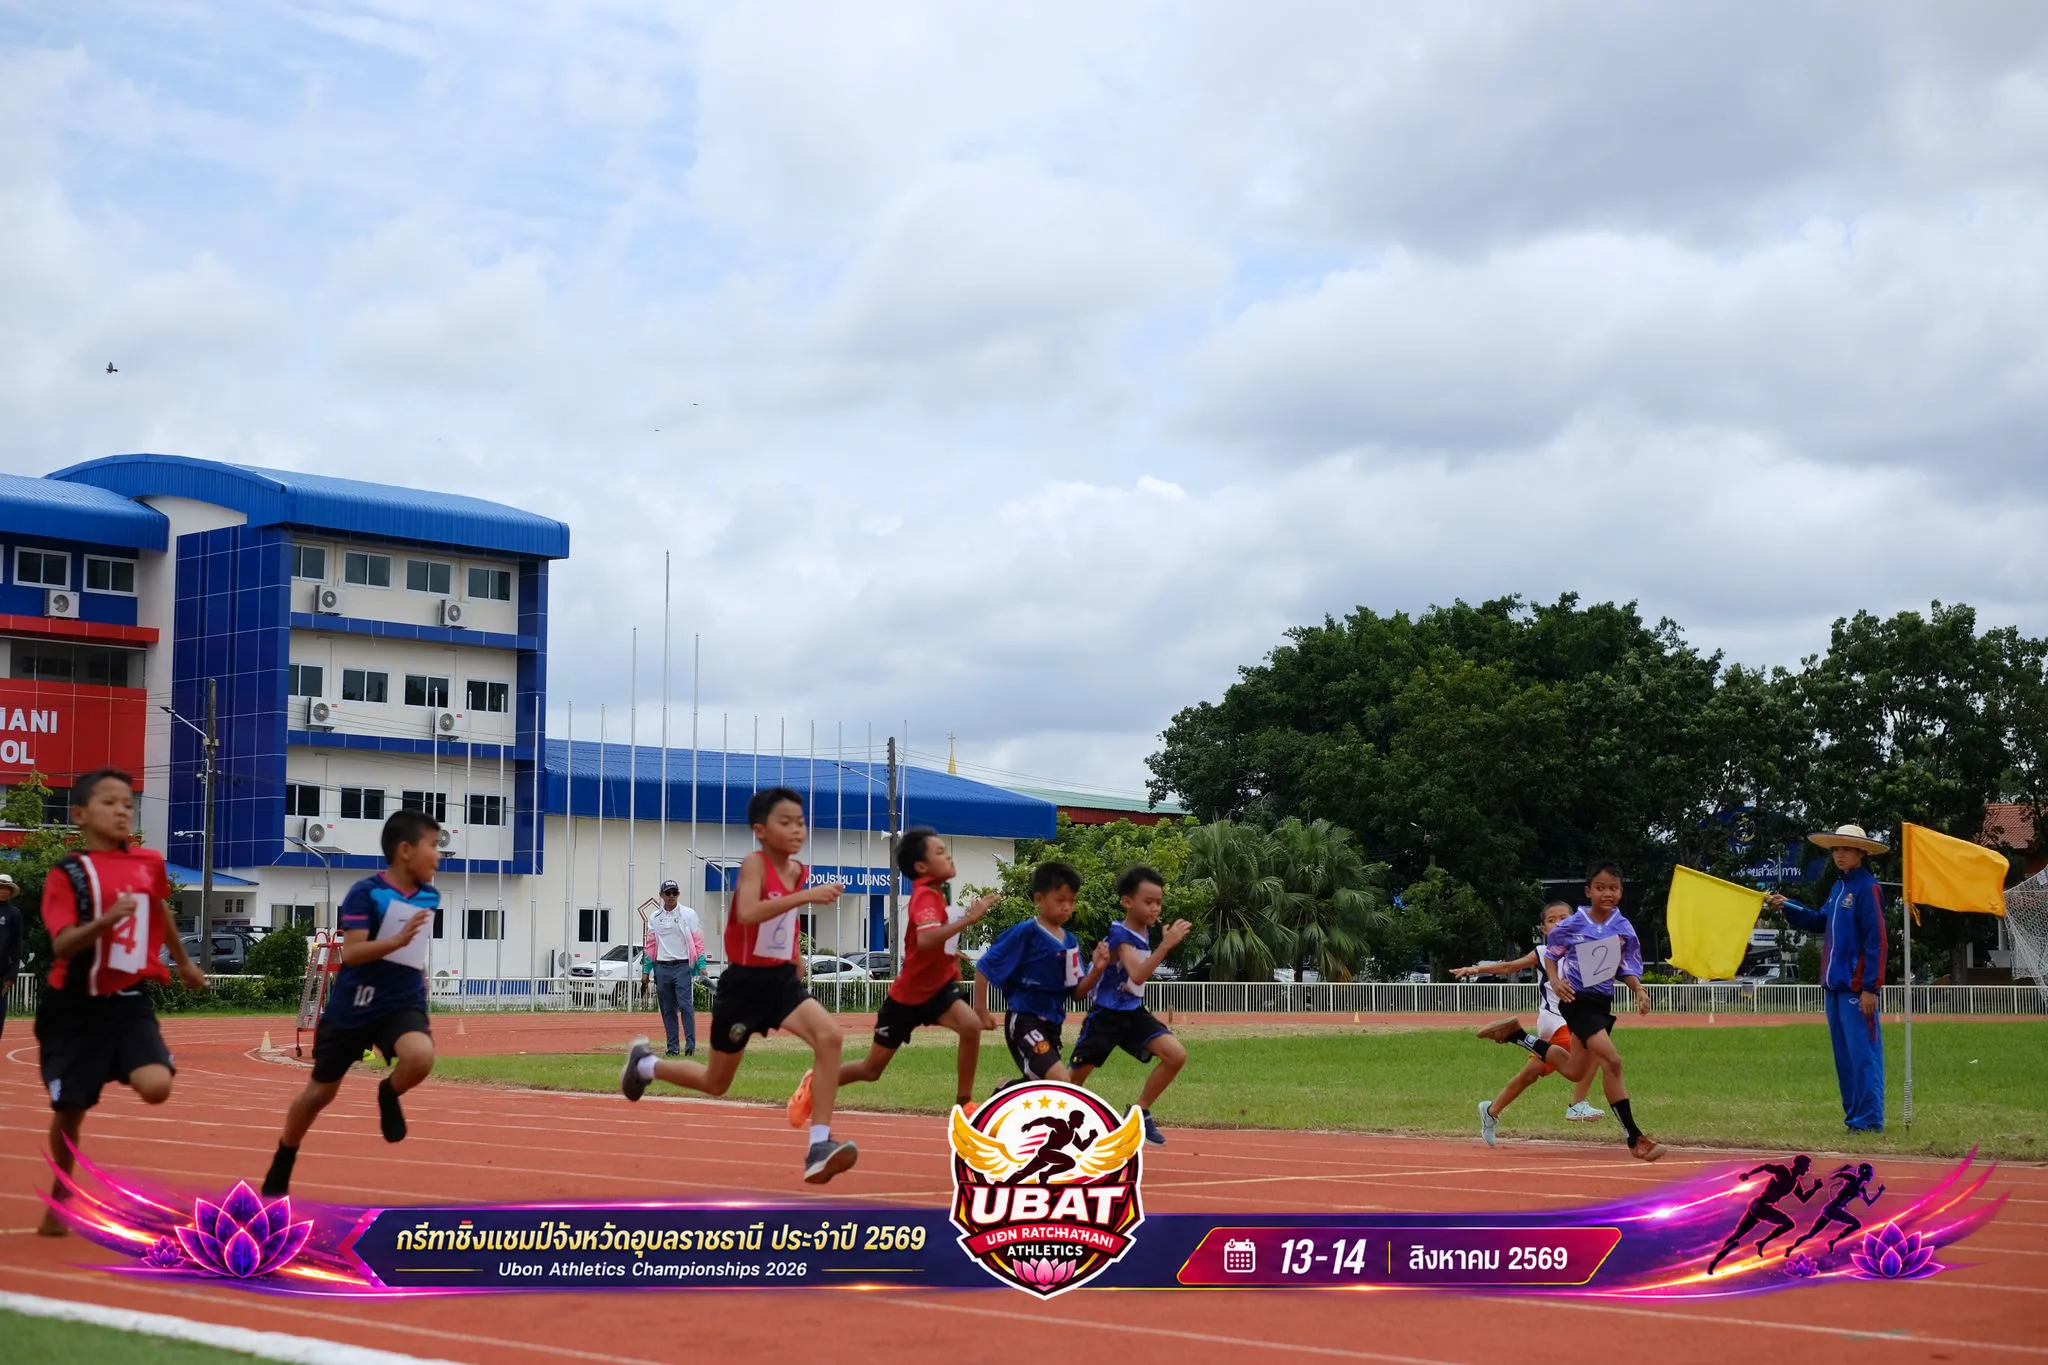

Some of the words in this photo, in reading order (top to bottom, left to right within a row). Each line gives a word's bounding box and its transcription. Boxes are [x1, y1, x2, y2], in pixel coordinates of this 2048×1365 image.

[111, 914, 138, 955] 4
[772, 911, 788, 946] 6
[1592, 945, 1611, 976] 2
[354, 984, 375, 1006] 10
[1023, 1029, 1044, 1047] 10
